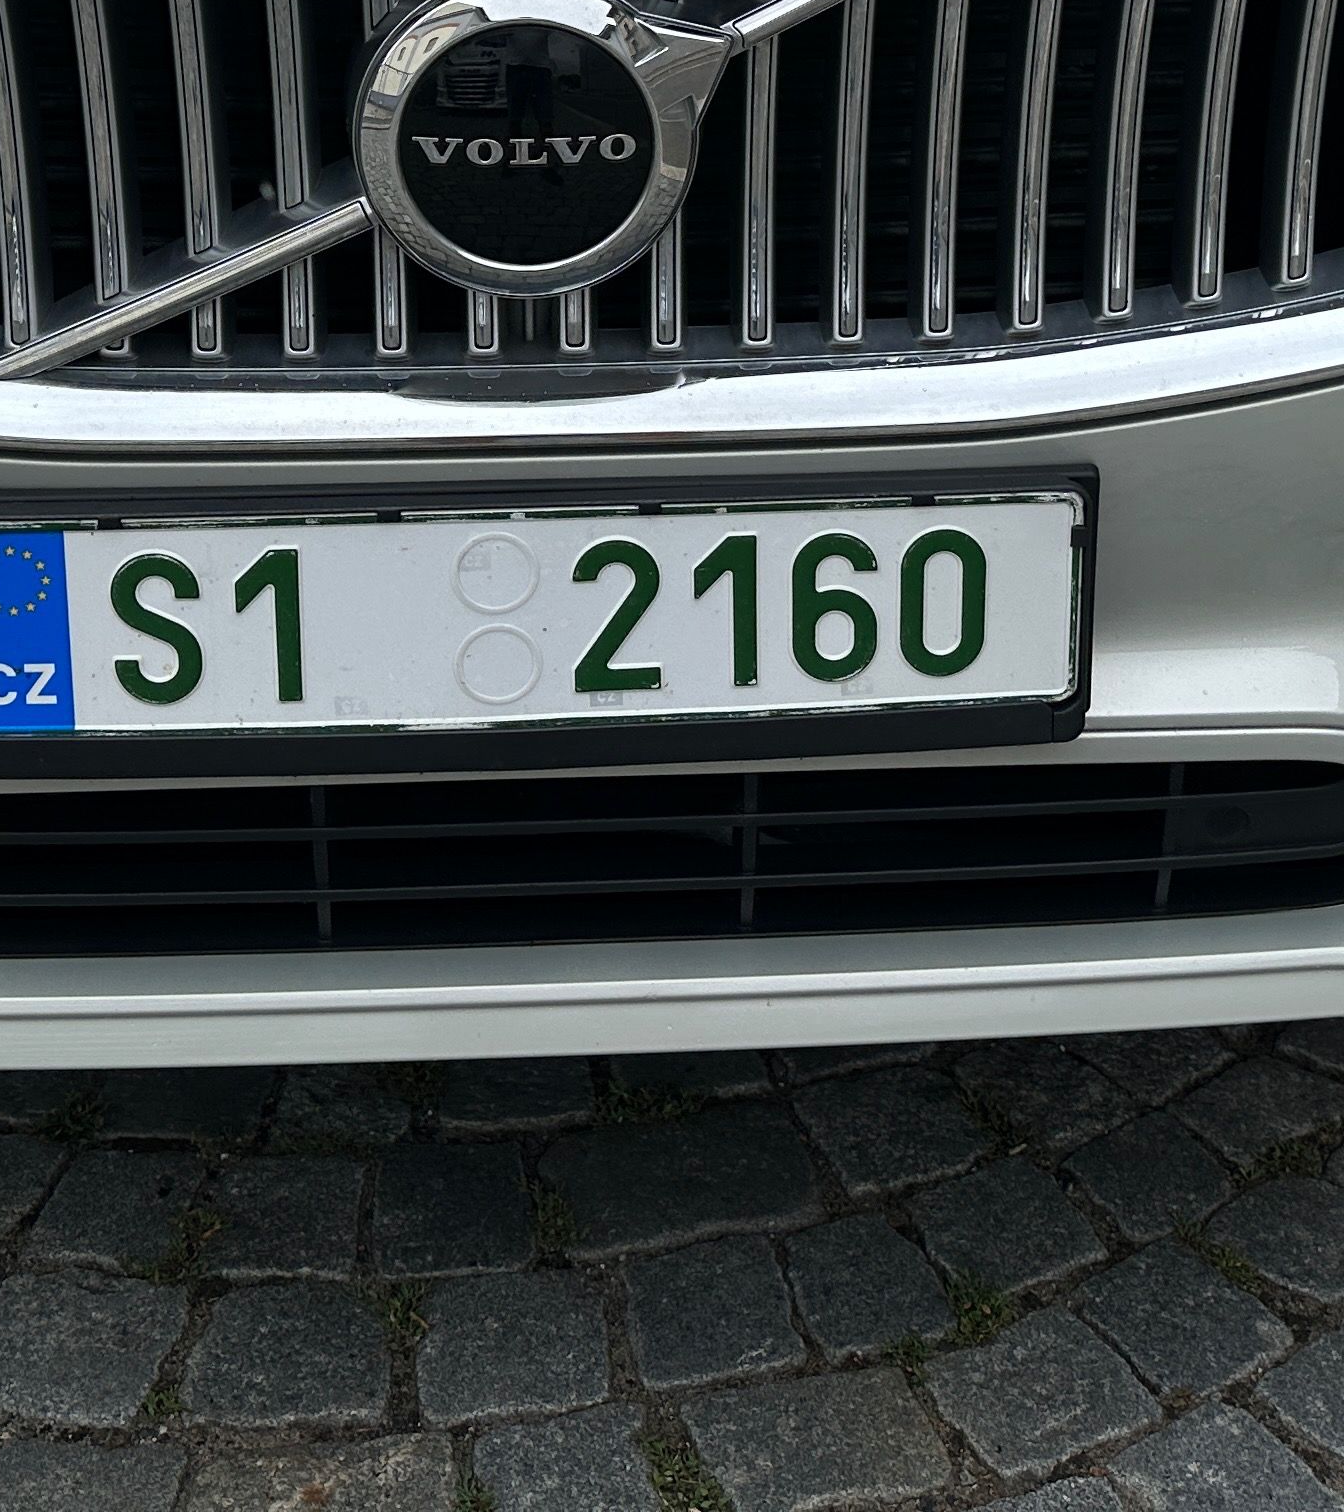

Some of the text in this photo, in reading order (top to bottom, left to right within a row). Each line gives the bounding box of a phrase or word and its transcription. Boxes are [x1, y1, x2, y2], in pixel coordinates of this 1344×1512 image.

[412, 133, 637, 166] VOLVO
[110, 528, 988, 705] S1 2160
